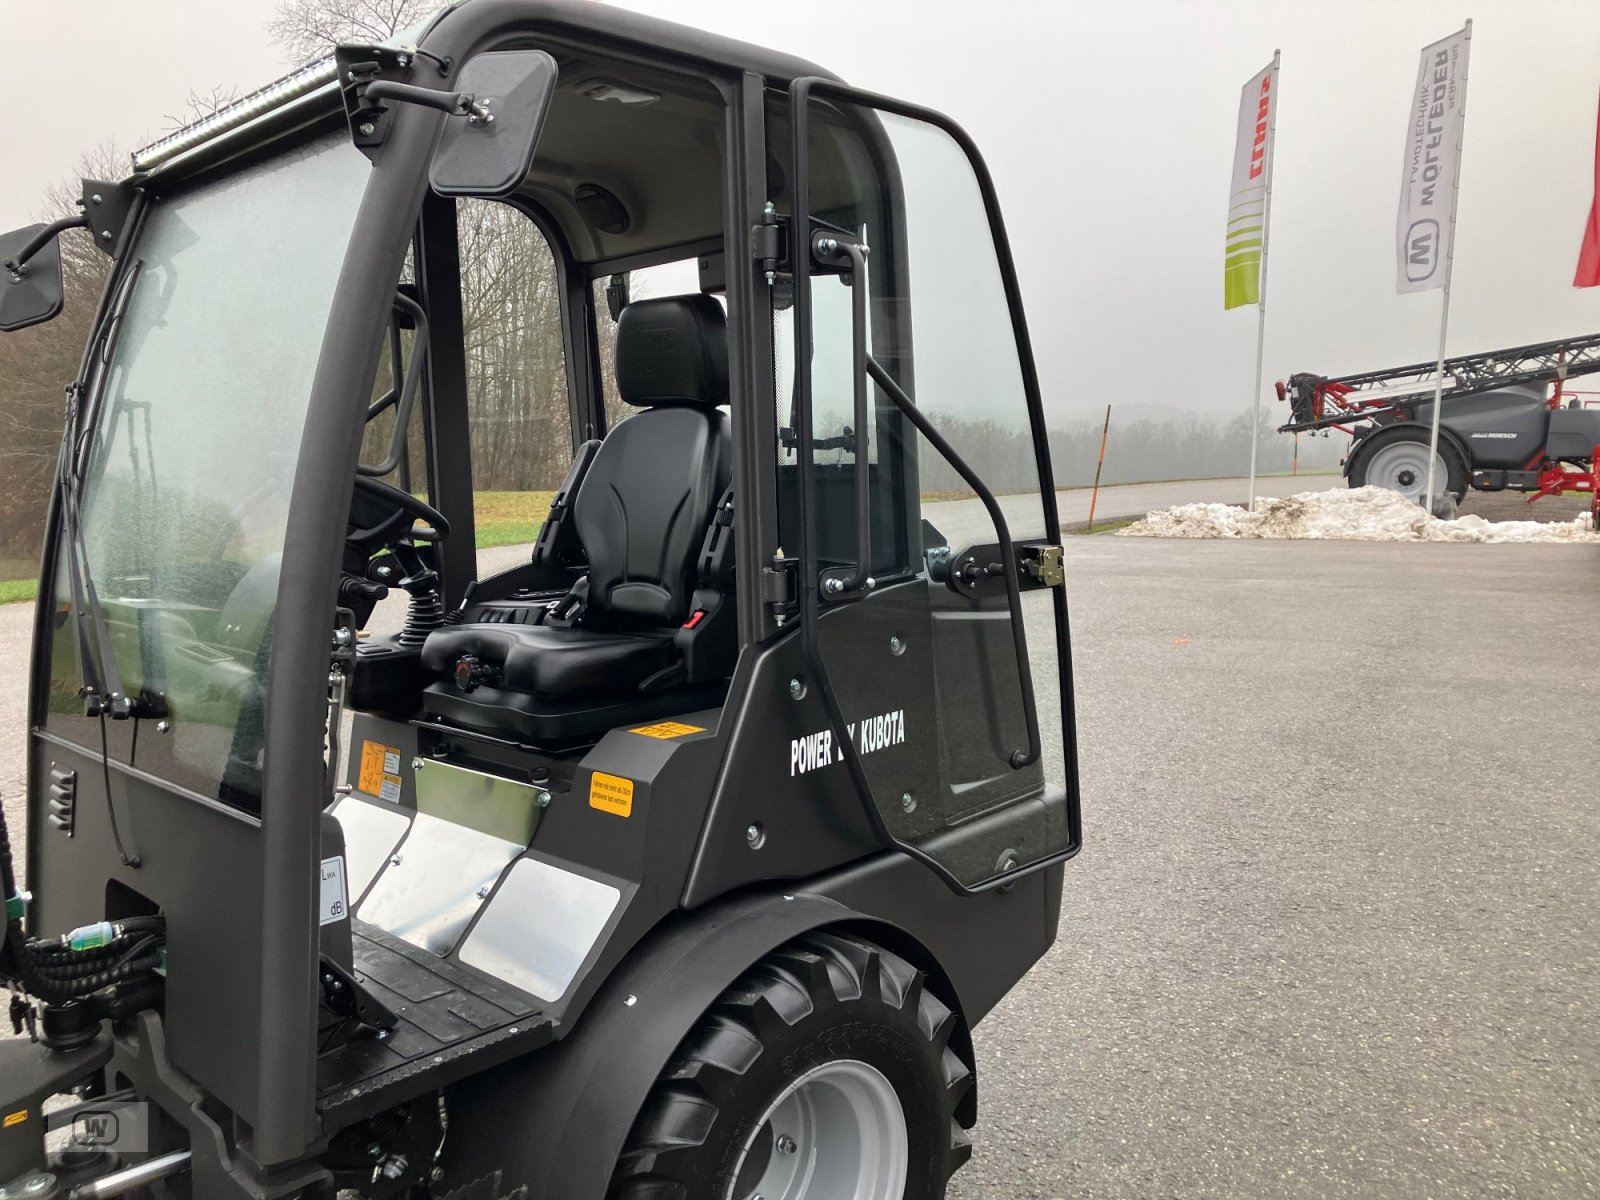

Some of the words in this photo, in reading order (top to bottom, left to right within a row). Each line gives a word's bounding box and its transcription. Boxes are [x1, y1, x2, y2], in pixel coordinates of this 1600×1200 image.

[791, 729, 832, 777] POWER
[861, 709, 905, 755] KUBOTA
[330, 901, 343, 916] dB
